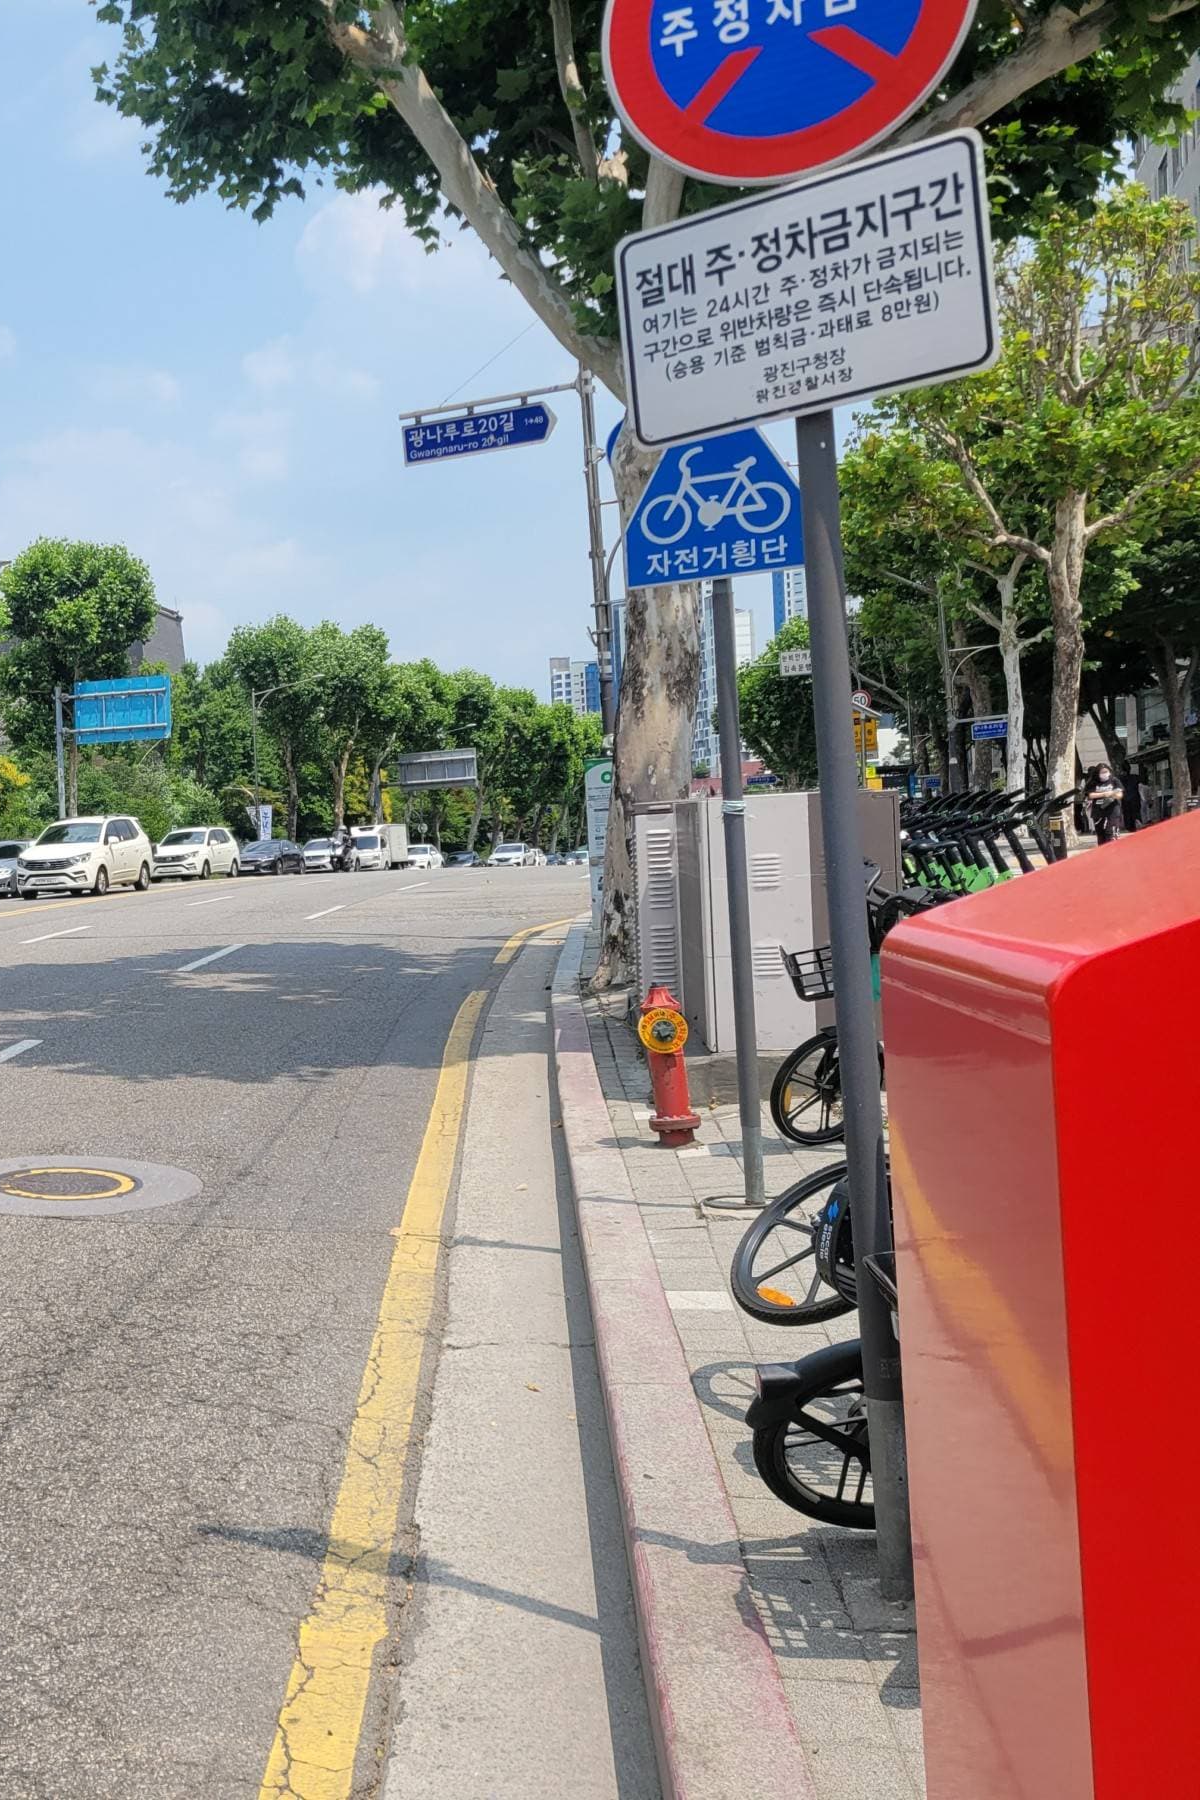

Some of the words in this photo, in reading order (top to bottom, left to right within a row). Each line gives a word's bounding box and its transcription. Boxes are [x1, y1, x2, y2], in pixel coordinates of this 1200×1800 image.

[635, 253, 697, 309] 절대
[642, 305, 698, 335] 여기는
[706, 282, 770, 319] 24시간
[876, 229, 965, 271] 금지되는
[643, 327, 715, 363] 구간으로
[719, 298, 813, 342] 위반차량은
[817, 286, 856, 313] 즉시
[863, 255, 972, 303] 단속됩니다.
[665, 354, 705, 383] (승용
[713, 343, 747, 367] 기준
[881, 290, 940, 323] 8만원)
[763, 347, 846, 383] 광진구청장
[408, 411, 515, 448] 광나루로20길
[409, 439, 480, 460] Gwangnaru-ro
[646, 535, 789, 578] 자전거횡단
[853, 695, 867, 706] 50
